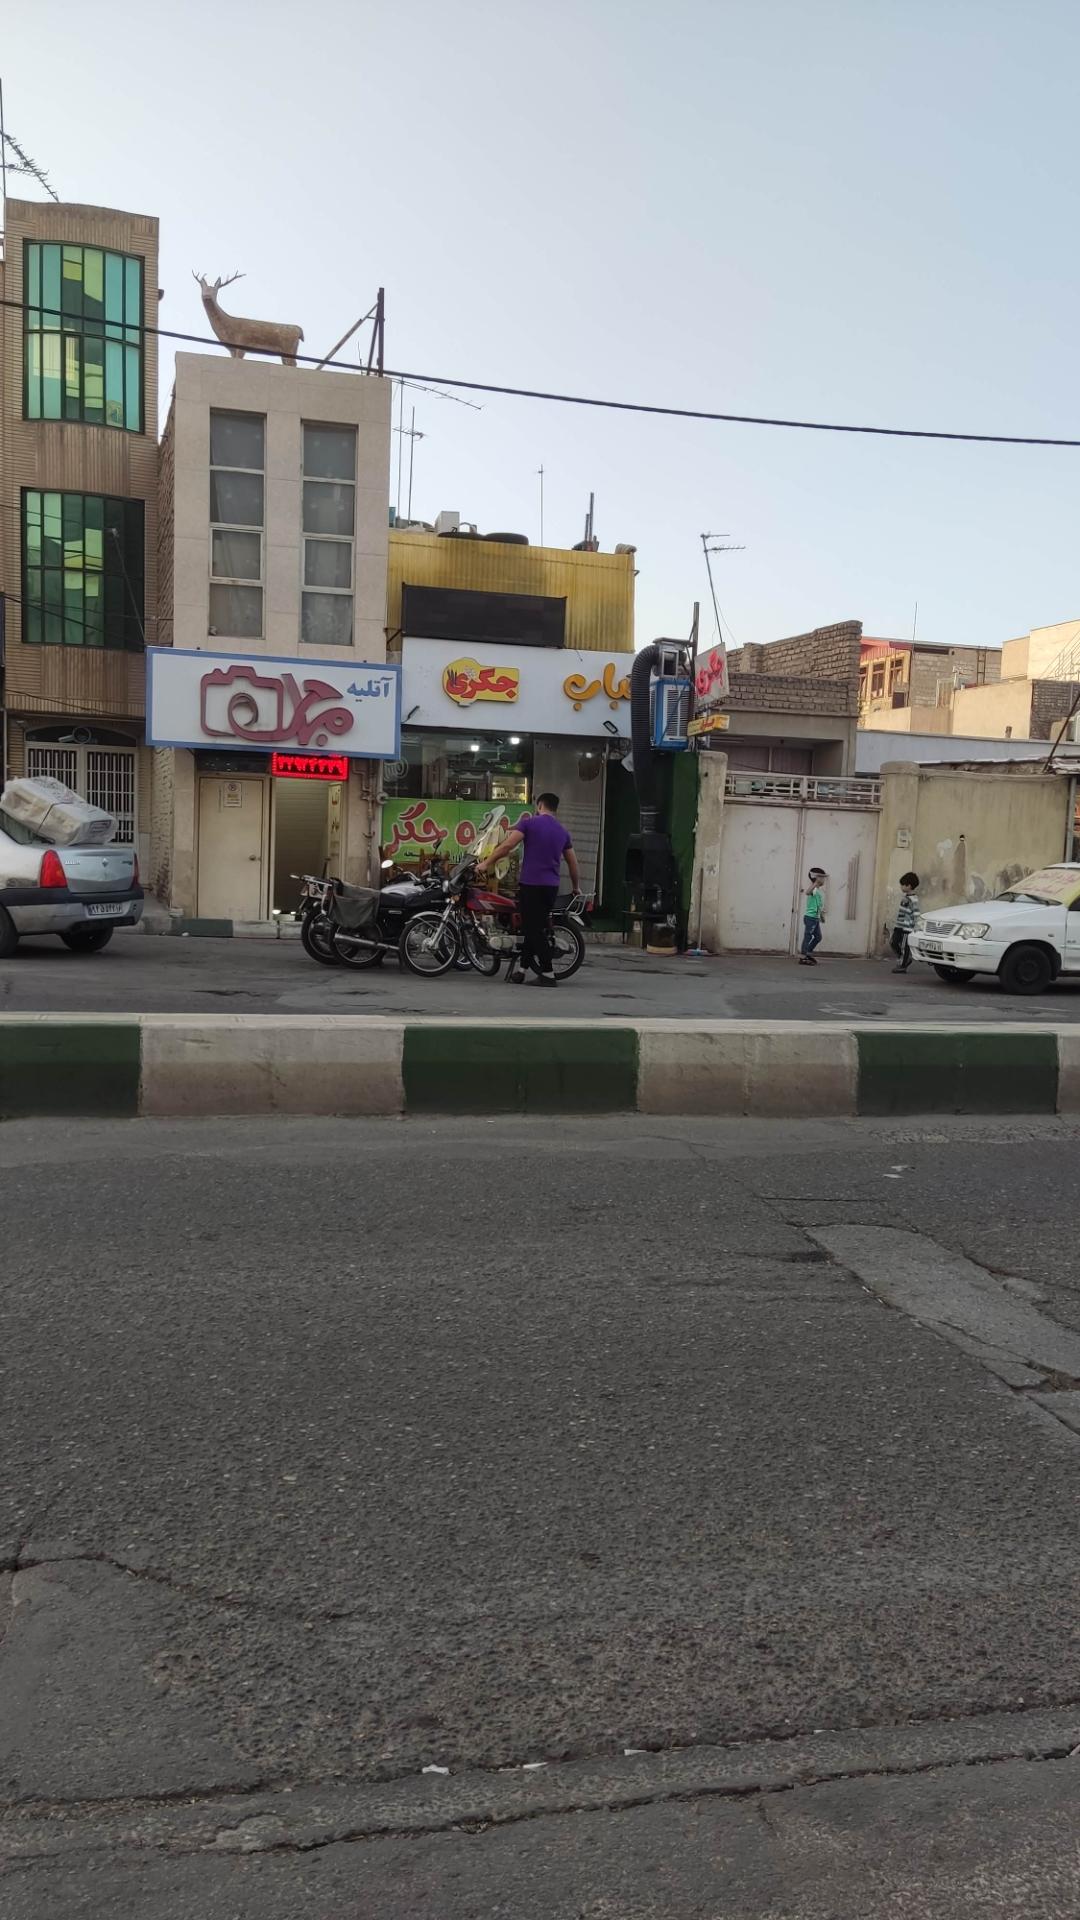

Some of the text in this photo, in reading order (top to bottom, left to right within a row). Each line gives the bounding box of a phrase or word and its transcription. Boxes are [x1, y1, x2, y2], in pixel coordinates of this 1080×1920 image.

[347, 676, 394, 702] آتلیه
[446, 668, 519, 699] جگری
[563, 663, 631, 712] باب
